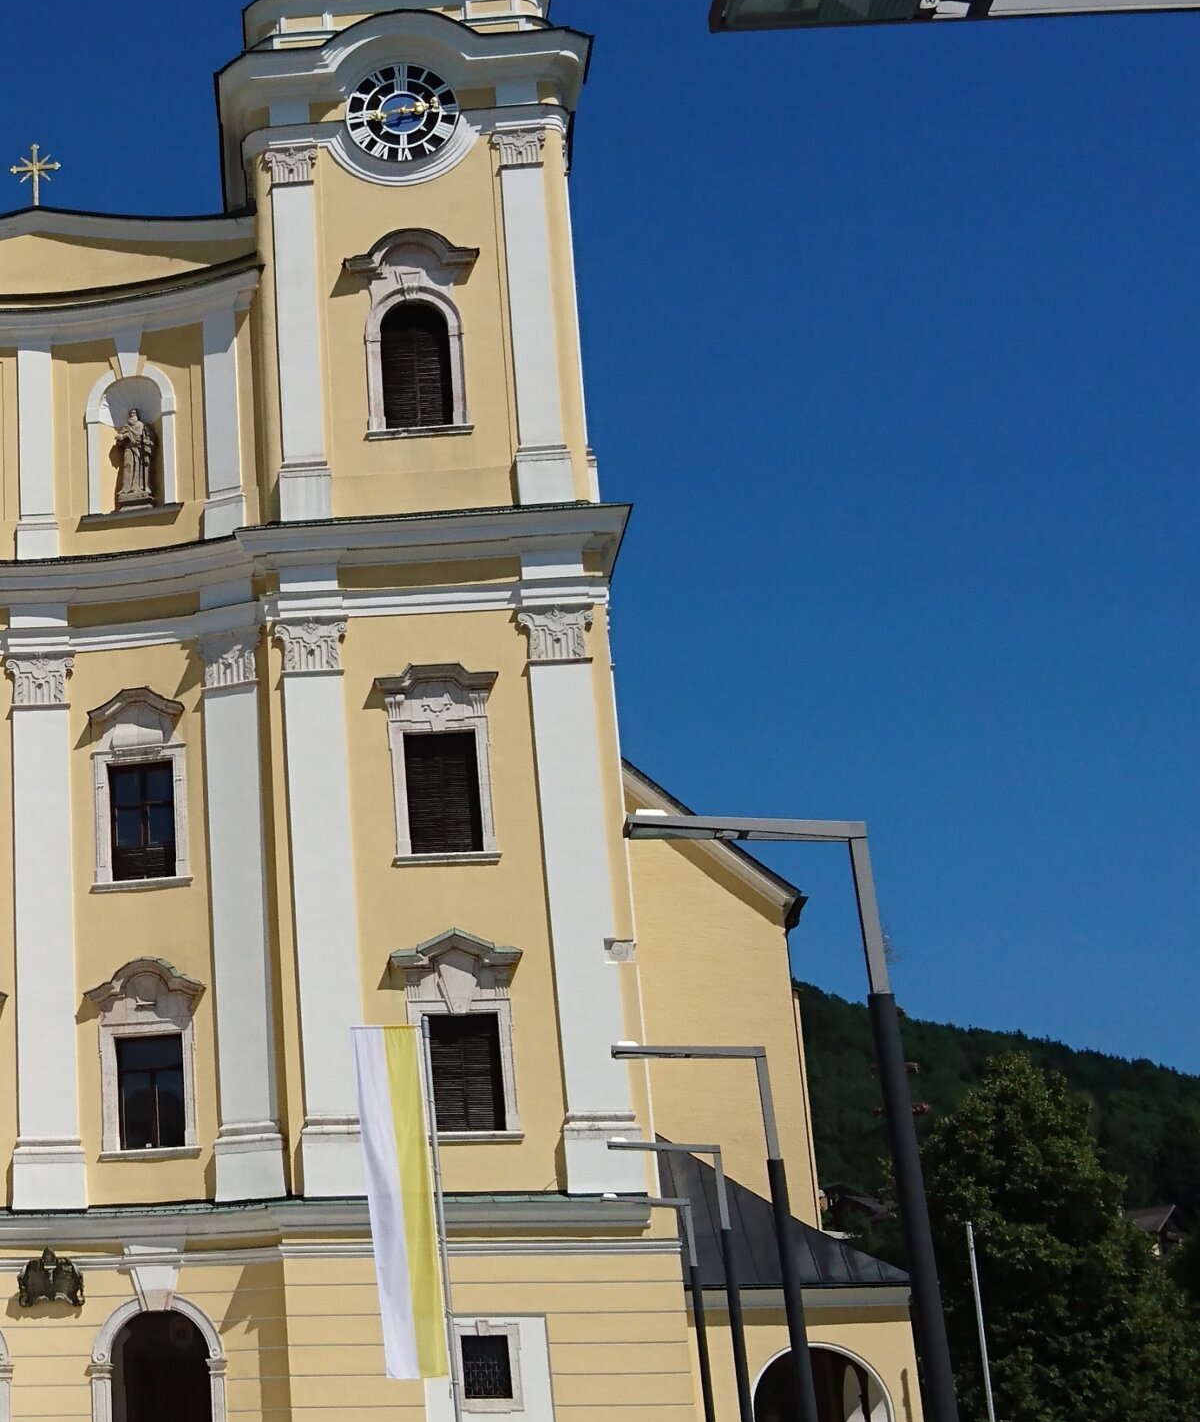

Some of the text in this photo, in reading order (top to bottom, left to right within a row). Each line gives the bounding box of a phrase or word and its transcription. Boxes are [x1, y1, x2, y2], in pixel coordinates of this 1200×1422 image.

[393, 63, 408, 80] XII
[398, 147, 413, 161] VI
[422, 141, 437, 155] V
